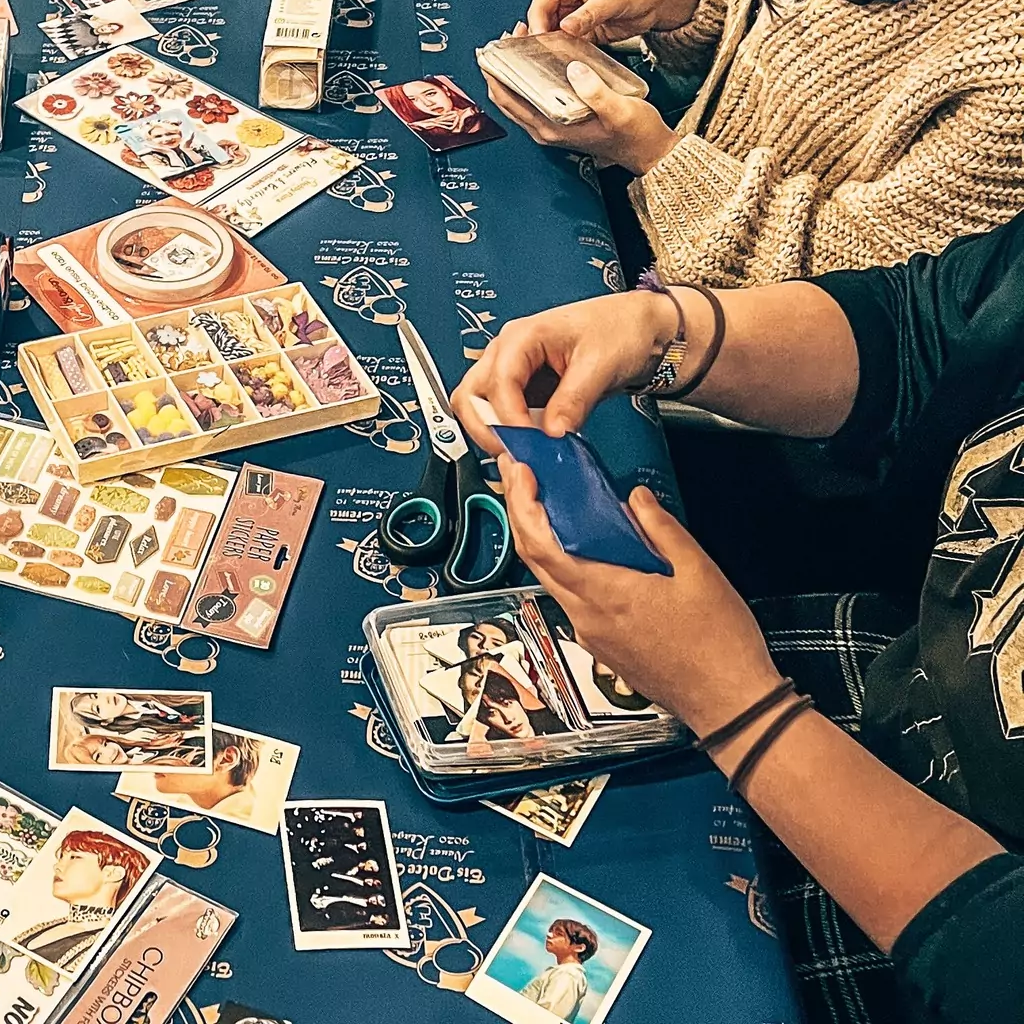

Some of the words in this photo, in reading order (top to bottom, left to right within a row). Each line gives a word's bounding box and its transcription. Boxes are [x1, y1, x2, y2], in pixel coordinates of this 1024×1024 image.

[314, 254, 352, 264] Crema
[353, 256, 388, 266] Dolce
[389, 257, 410, 266] Eis
[79, 280, 98, 300] sided
[97, 298, 120, 322] double
[336, 498, 347, 506] 10
[330, 509, 374, 522] Crema
[137, 534, 152, 555] Relax
[222, 517, 254, 560] STICKERS
[246, 526, 280, 562] PAPER
[206, 596, 228, 618] Today
[438, 836, 470, 844] 9020
[429, 848, 474, 862] Neuer
[408, 862, 454, 881] Dolce
[458, 867, 486, 884] Eis
[103, 958, 132, 995] STICKERS
[88, 995, 106, 1017] WITH
